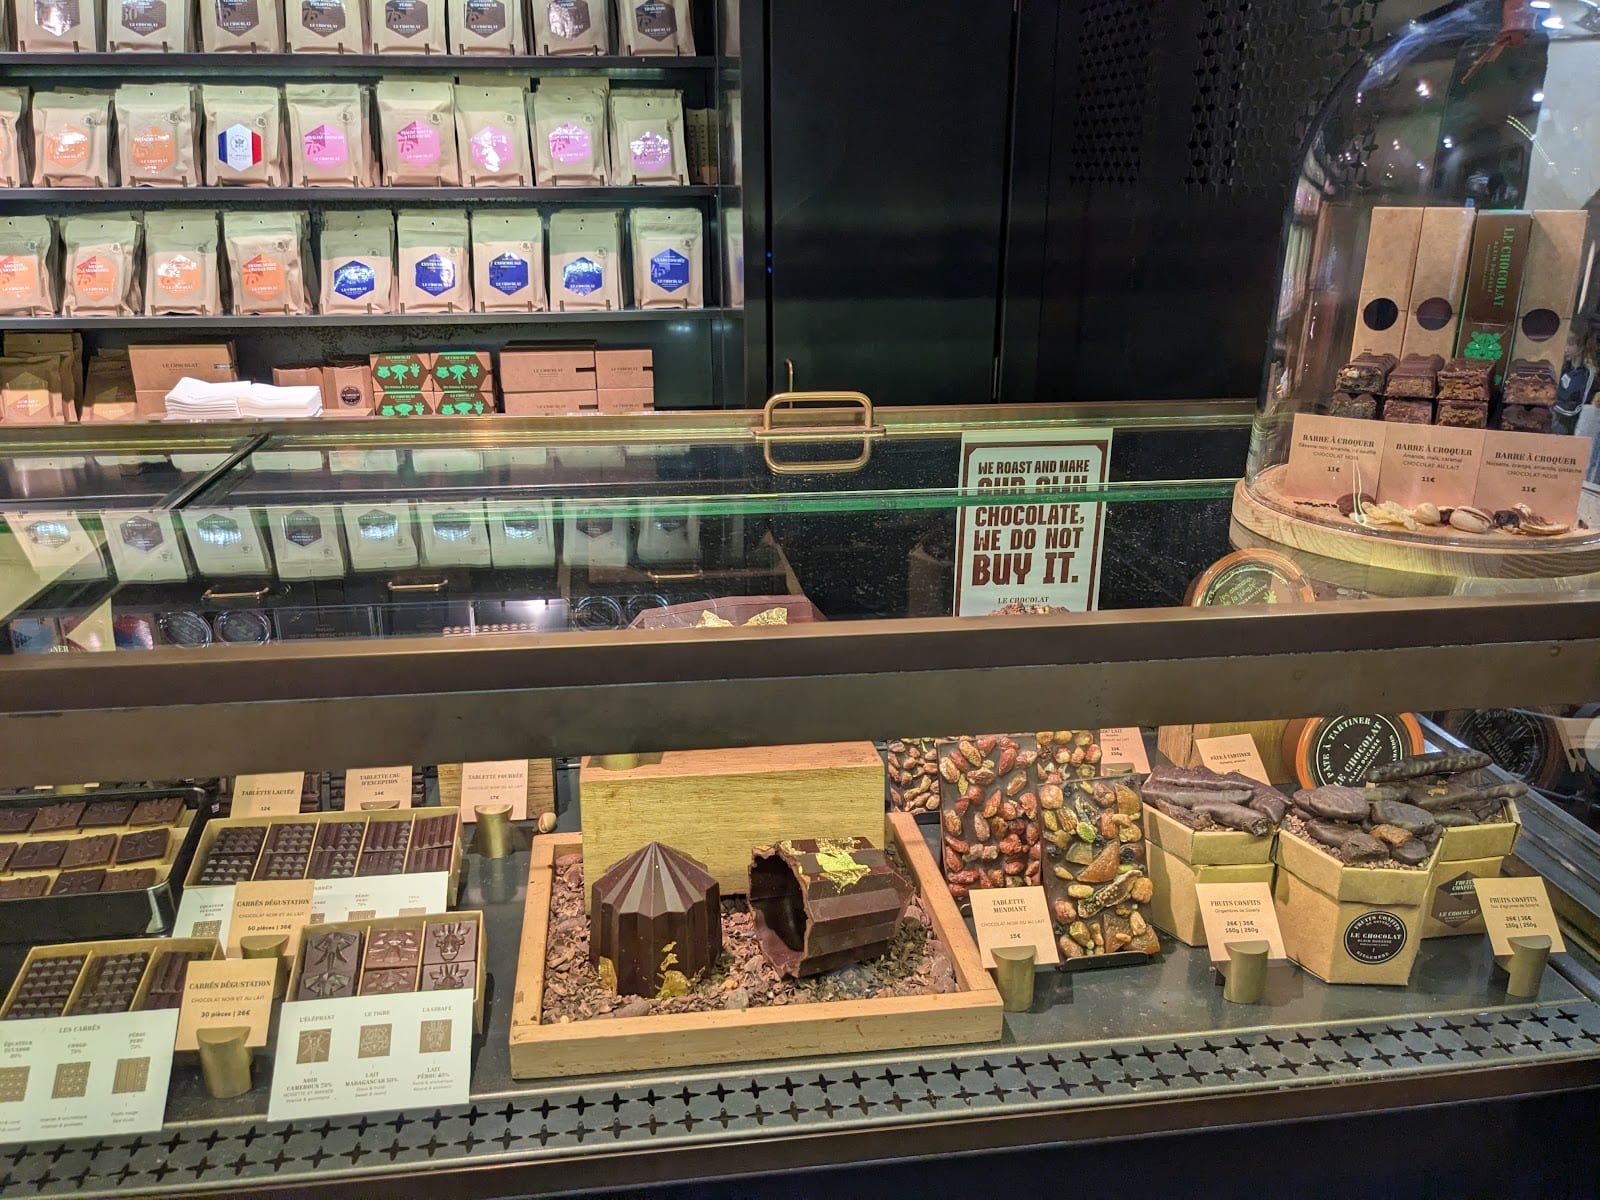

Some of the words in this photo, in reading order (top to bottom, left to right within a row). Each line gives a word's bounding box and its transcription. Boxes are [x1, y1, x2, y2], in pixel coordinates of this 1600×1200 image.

[1503, 226, 1515, 242] LE
[1493, 246, 1512, 308] CHOCOLAT
[1303, 434, 1330, 443] BARRE
[1337, 438, 1375, 448] CROQUER
[1396, 443, 1424, 452] BARRE
[1433, 446, 1473, 456] CROQUER
[1495, 451, 1525, 461] BARRE
[1534, 455, 1577, 465] CROQUER
[978, 462, 994, 475] WE
[996, 461, 1032, 474] ROAST
[1034, 460, 1057, 473] AND
[1059, 459, 1090, 473] MAKE
[975, 504, 1084, 526] CHOCOLATE,
[973, 529, 1001, 551] WE
[1010, 528, 1037, 550] DO
[1045, 527, 1084, 549] NOT
[972, 552, 1032, 586] BUY
[1043, 551, 1079, 584] IT.
[1327, 716, 1371, 741] TARTINER
[1343, 721, 1383, 773] CHOCOLAT
[241, 789, 272, 797] TABLETTE
[236, 899, 263, 907] CARRÉS
[992, 898, 1025, 906] TABLETTE
[1448, 909, 1477, 917] CHOCOLAT
[1354, 915, 1377, 930] FRUITS
[1379, 915, 1401, 931] CONFITS
[189, 981, 220, 990] CARRÉS
[220, 979, 271, 989] DÉGUSTATION
